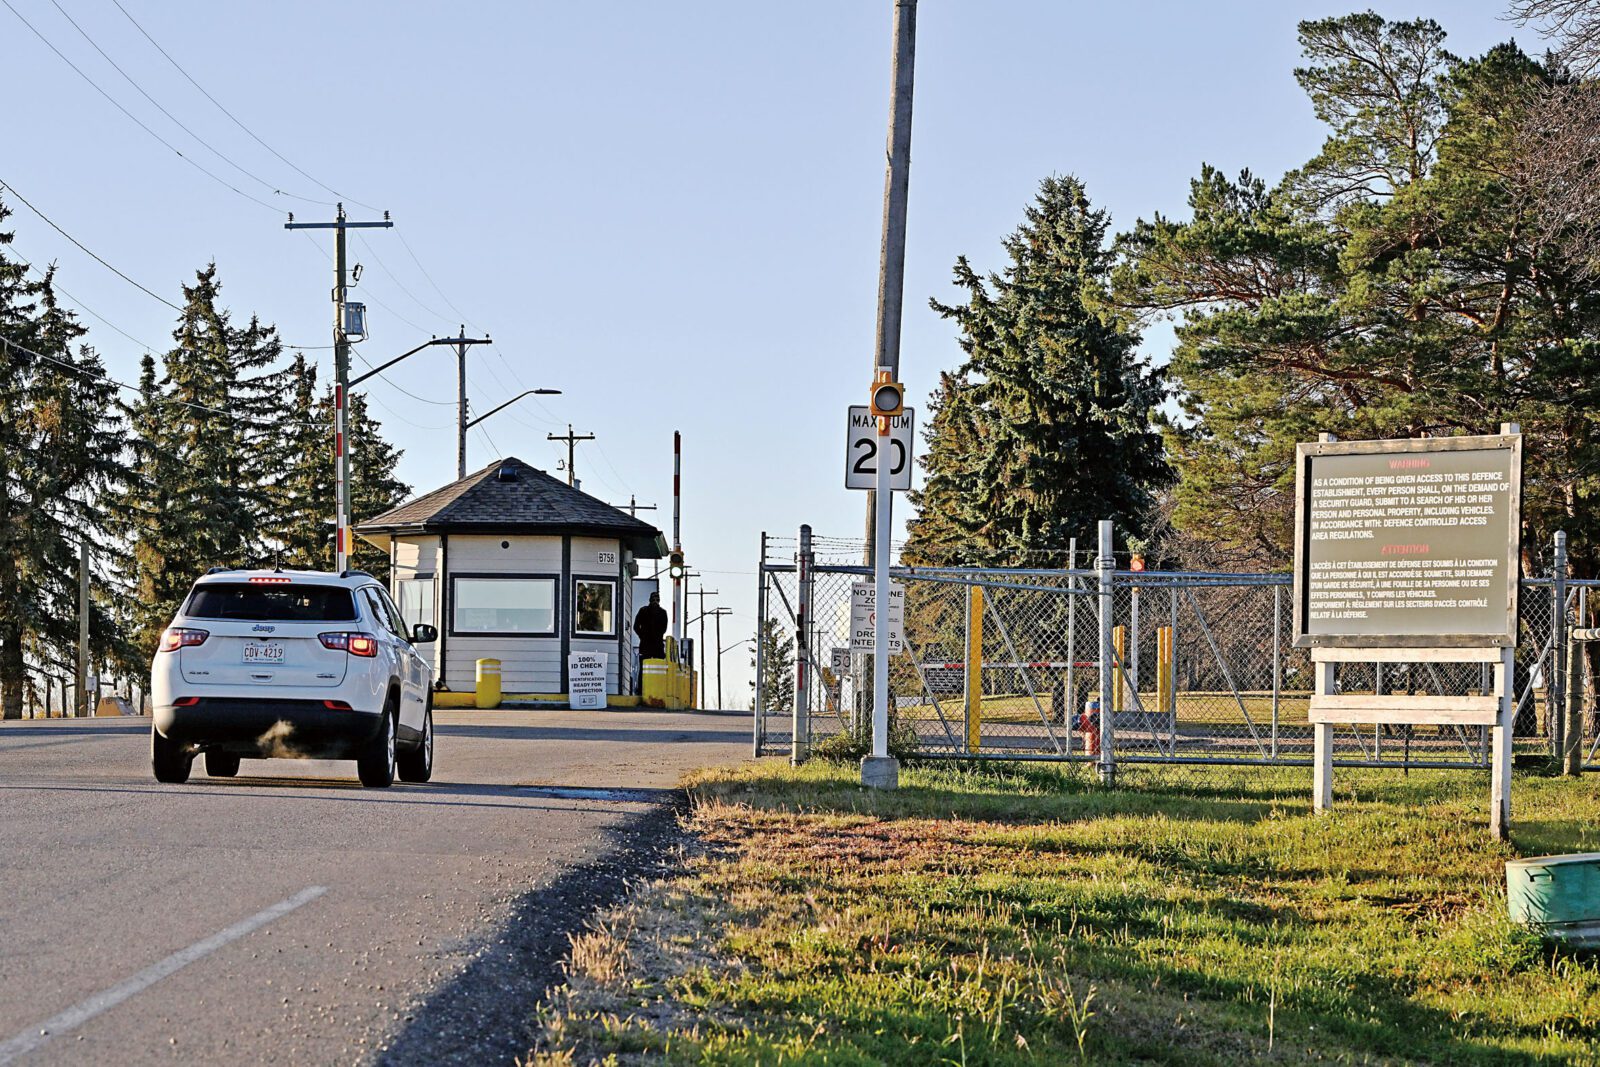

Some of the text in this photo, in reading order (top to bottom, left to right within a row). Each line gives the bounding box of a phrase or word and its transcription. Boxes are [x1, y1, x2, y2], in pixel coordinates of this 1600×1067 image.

[852, 415, 909, 428] MAXUM
[853, 438, 906, 474] 20
[1329, 477, 1363, 485] CONDITION
[1396, 475, 1415, 484] GIVEN
[1417, 474, 1443, 482] ACCESS
[1472, 472, 1502, 480] DEFENCE
[1313, 488, 1365, 497] ESTABLISHMENT,
[1388, 486, 1415, 494] PERSON
[1417, 485, 1440, 494] SHALL,
[1469, 483, 1498, 491] DEMAND
[1319, 499, 1348, 507] SECURITY
[1350, 498, 1374, 507] GUARD,
[1417, 496, 1442, 504] SEARCH
[1353, 509, 1386, 517] PERSONAL
[1388, 507, 1422, 516] PROPERTY,
[1424, 507, 1459, 515] INCLUDING
[1461, 506, 1494, 514] VEHICLES.
[1320, 520, 1363, 528] ACCORDANCE
[1414, 518, 1457, 526] CONTROLLED
[1312, 531, 1374, 540] AREA REGULATIONS.
[599, 552, 614, 562] B758
[856, 630, 896, 638] DROS
[852, 639, 900, 647] INTETS
